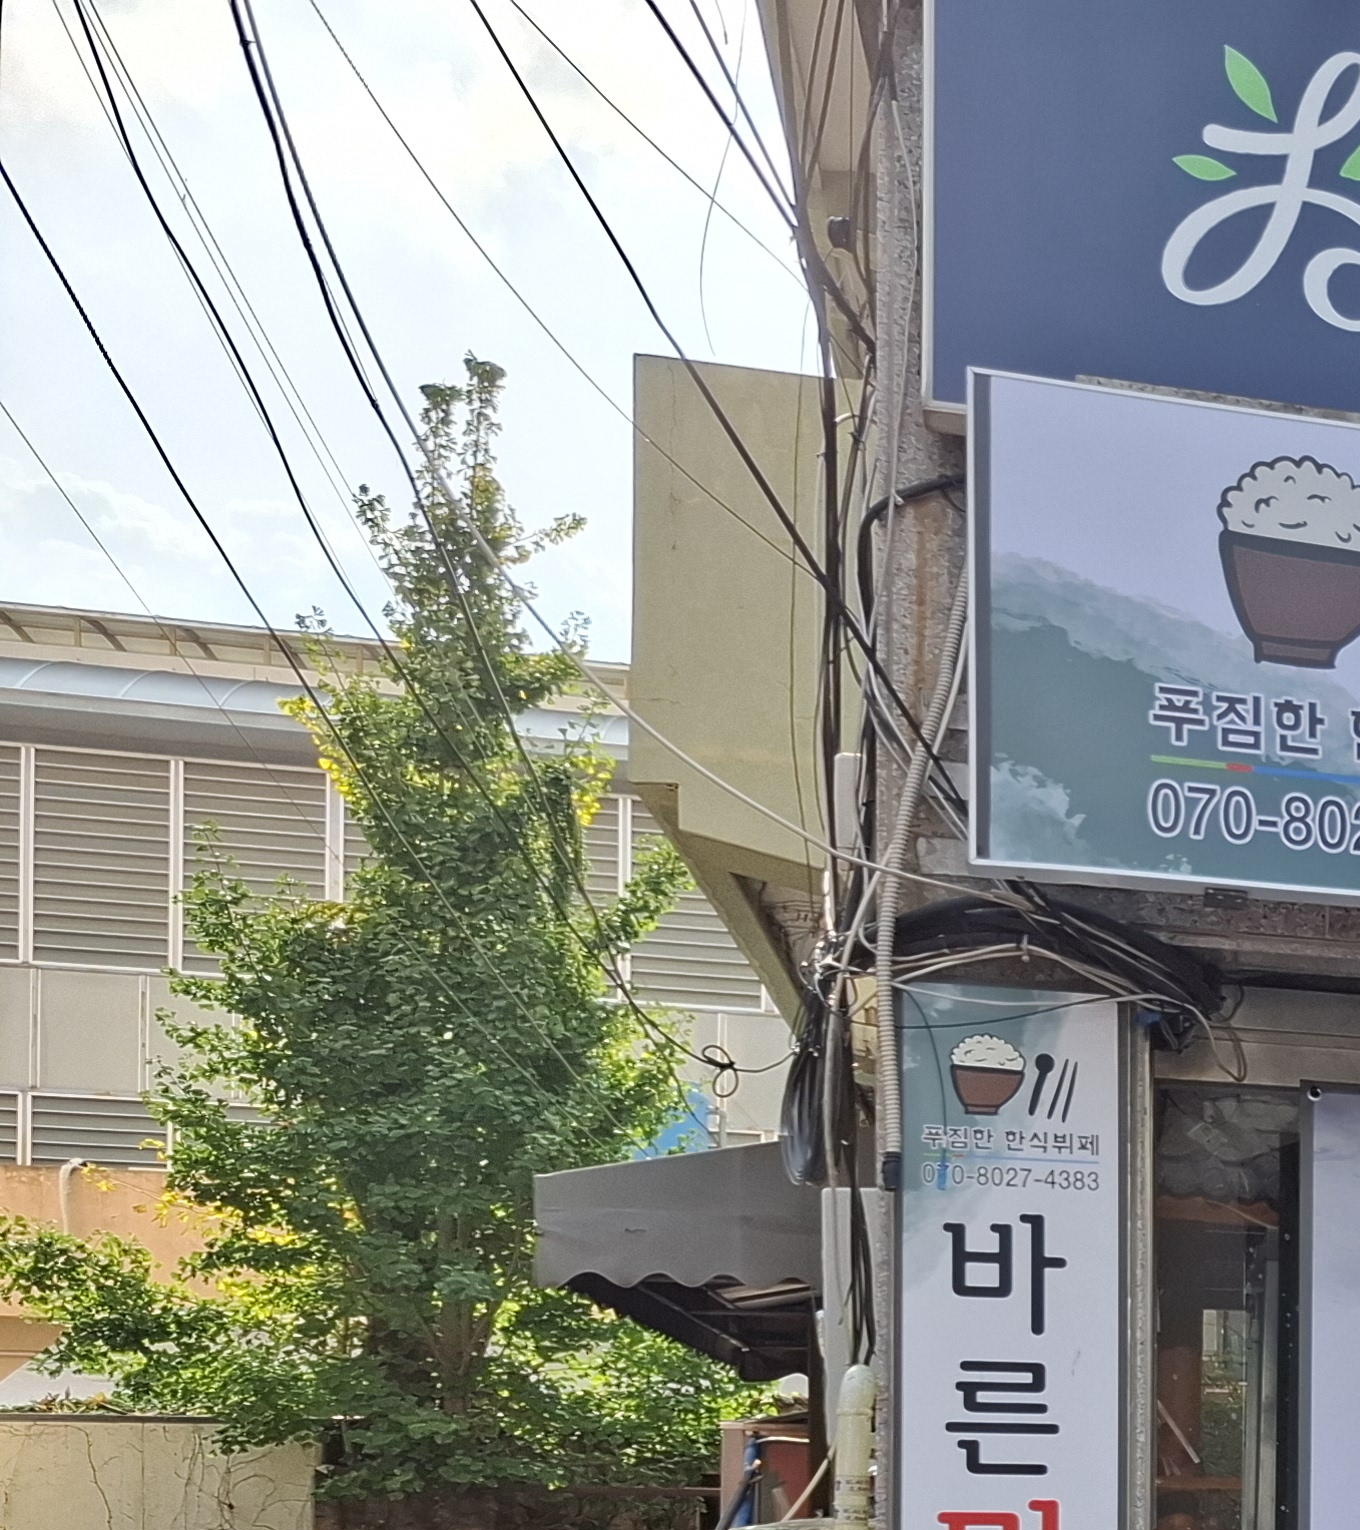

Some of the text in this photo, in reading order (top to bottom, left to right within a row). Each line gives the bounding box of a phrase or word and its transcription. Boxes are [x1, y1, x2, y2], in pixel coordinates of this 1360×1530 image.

[1150, 683, 1326, 758] 푸짐한
[922, 1126, 1100, 1157] 푸짐한 한식뷔페
[922, 1163, 1101, 1192] 00-8027-4383
